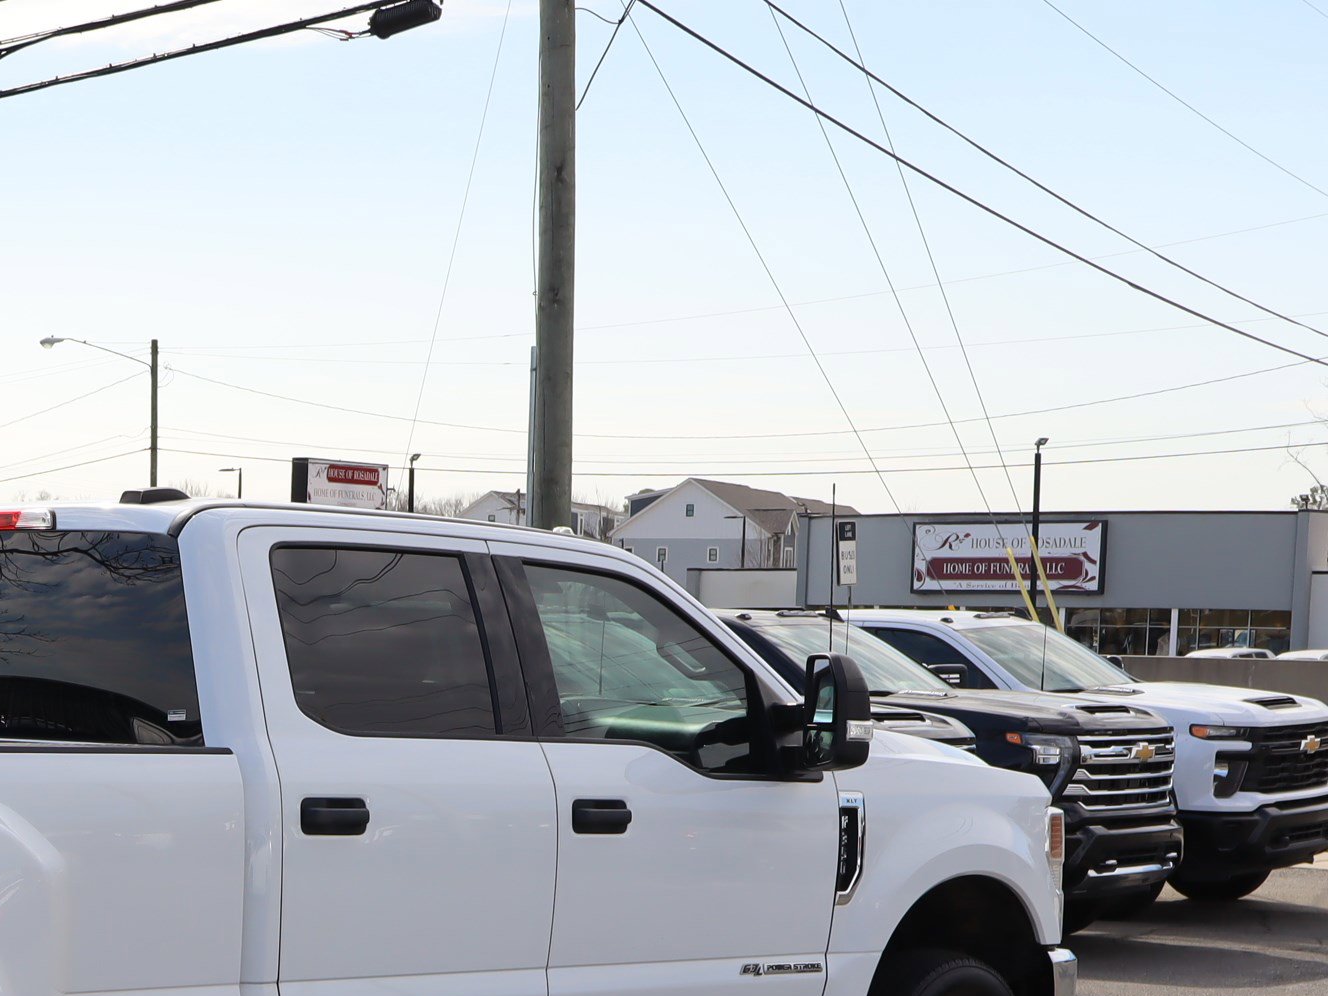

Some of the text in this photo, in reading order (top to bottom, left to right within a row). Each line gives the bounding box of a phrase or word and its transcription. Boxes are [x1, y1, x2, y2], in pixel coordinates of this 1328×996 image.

[971, 537, 1007, 549] HOUSE
[1011, 537, 1026, 549] OF
[1031, 536, 1087, 549] OSADALE
[943, 562, 972, 575] HOME
[974, 562, 988, 575] OF
[1046, 562, 1065, 574] LLC
[792, 962, 822, 971] STROKE
